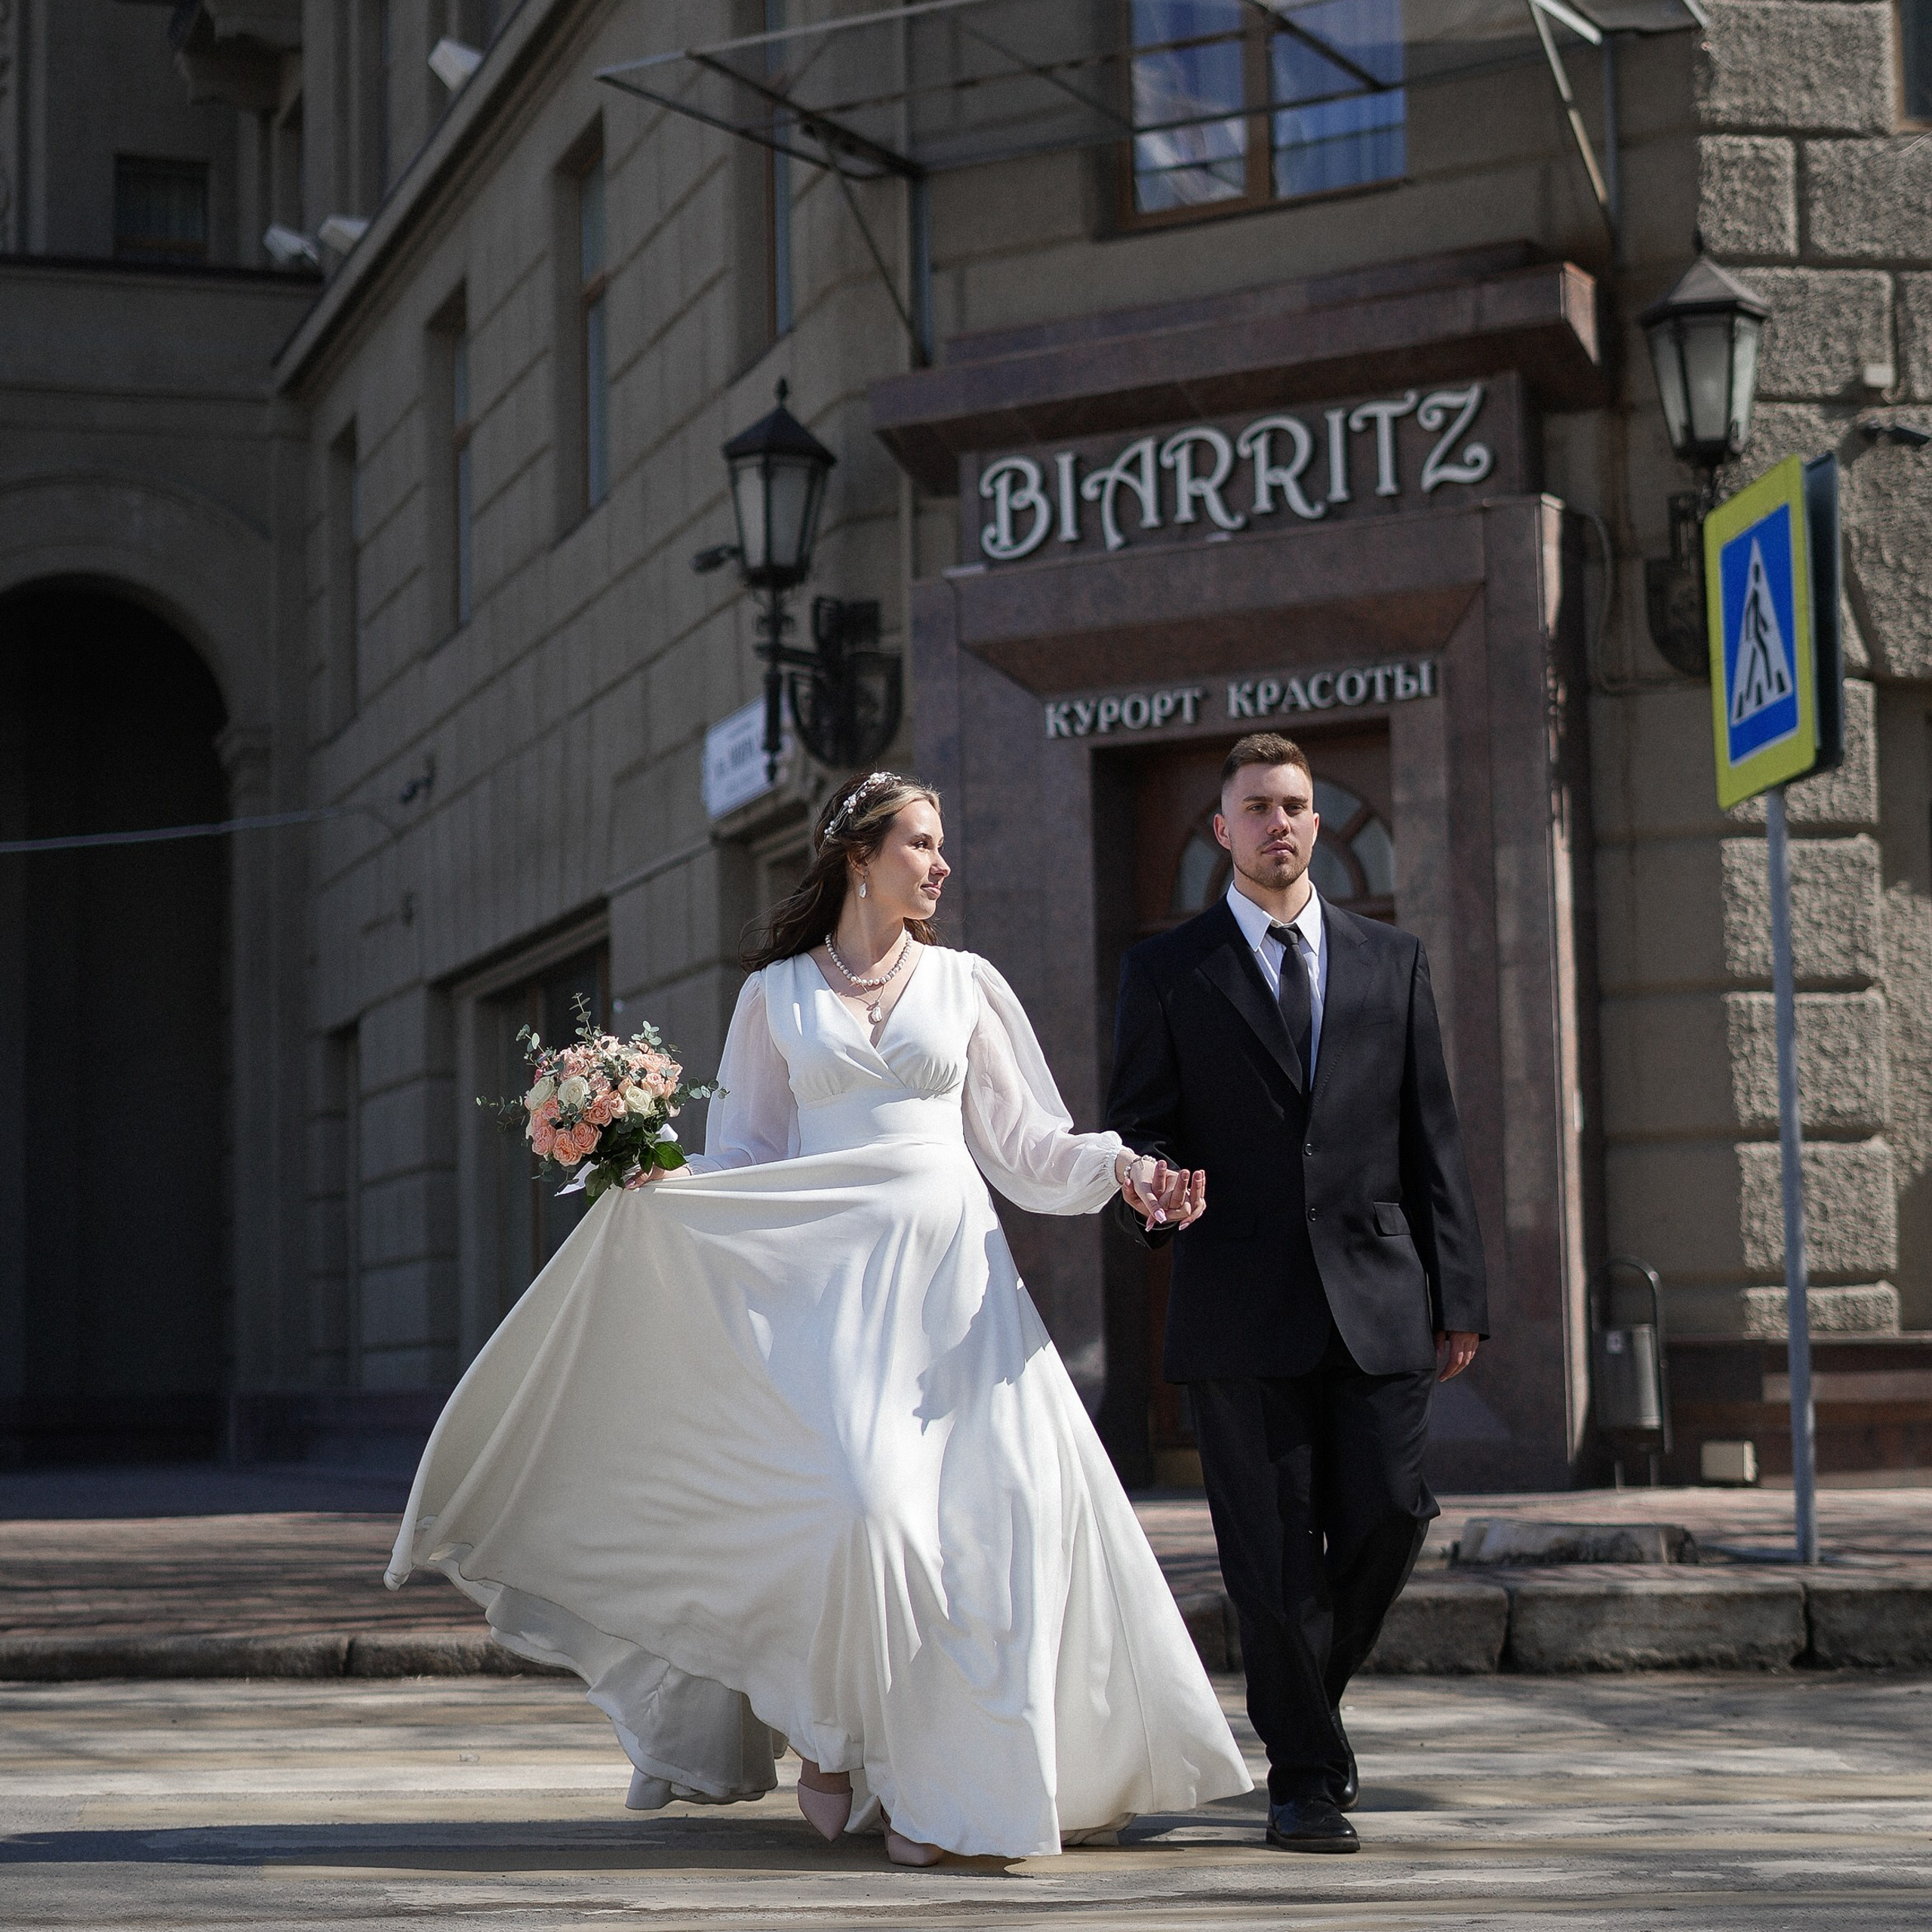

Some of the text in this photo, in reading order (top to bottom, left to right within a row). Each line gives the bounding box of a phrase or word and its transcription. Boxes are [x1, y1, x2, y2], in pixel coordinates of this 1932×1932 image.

[980, 383, 1494, 560] BIARRITZ
[1045, 660, 1437, 740] КУРОРТ КРАСОТЫ
